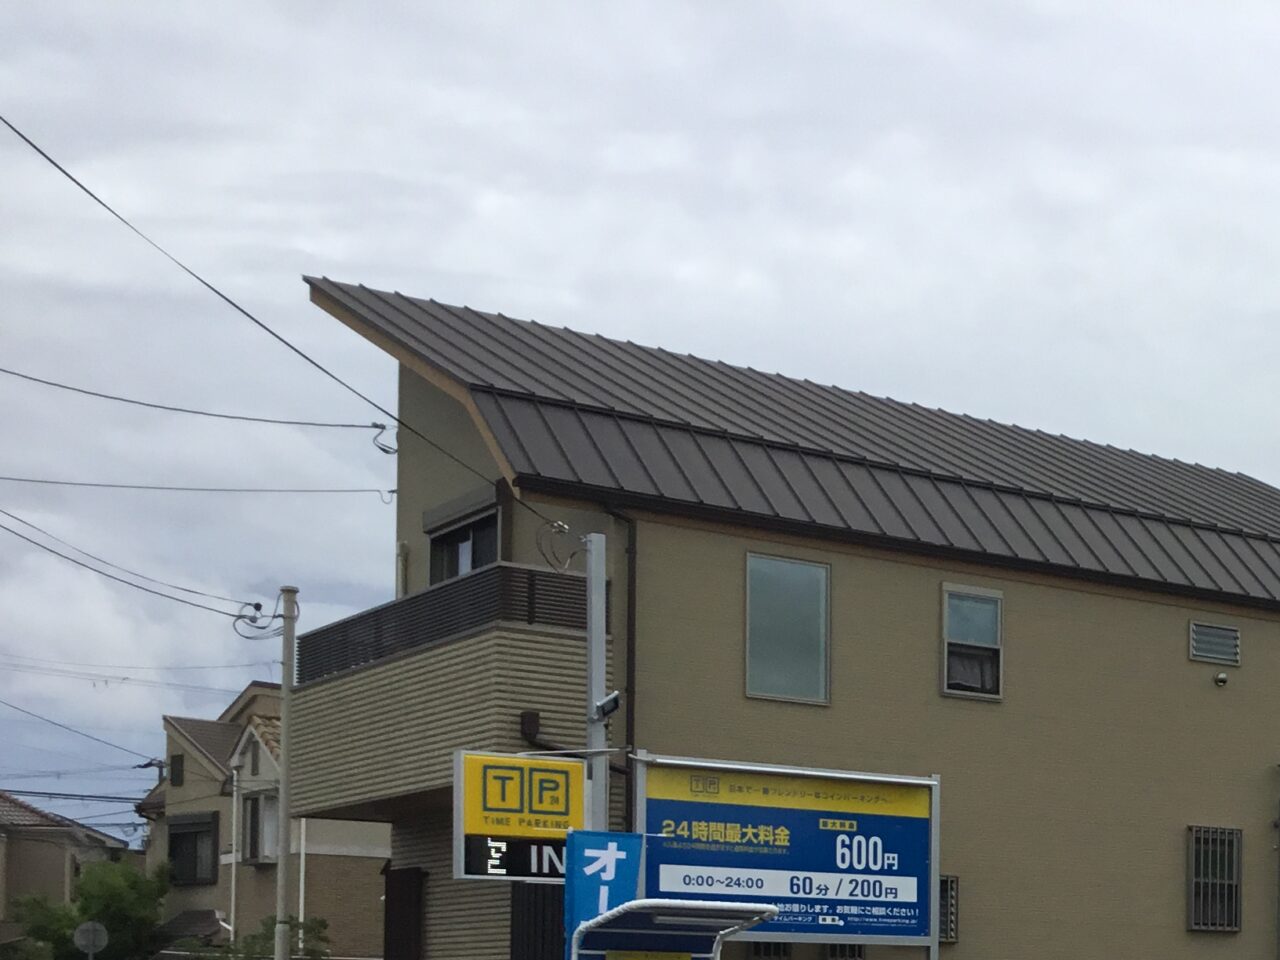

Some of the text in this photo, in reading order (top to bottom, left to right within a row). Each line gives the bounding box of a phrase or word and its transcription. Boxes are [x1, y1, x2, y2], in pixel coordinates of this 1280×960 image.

[483, 815, 570, 829] TIME PARKING
[662, 819, 790, 847] 24時間最大料金
[530, 845, 567, 874] IN
[835, 833, 899, 871] 600円
